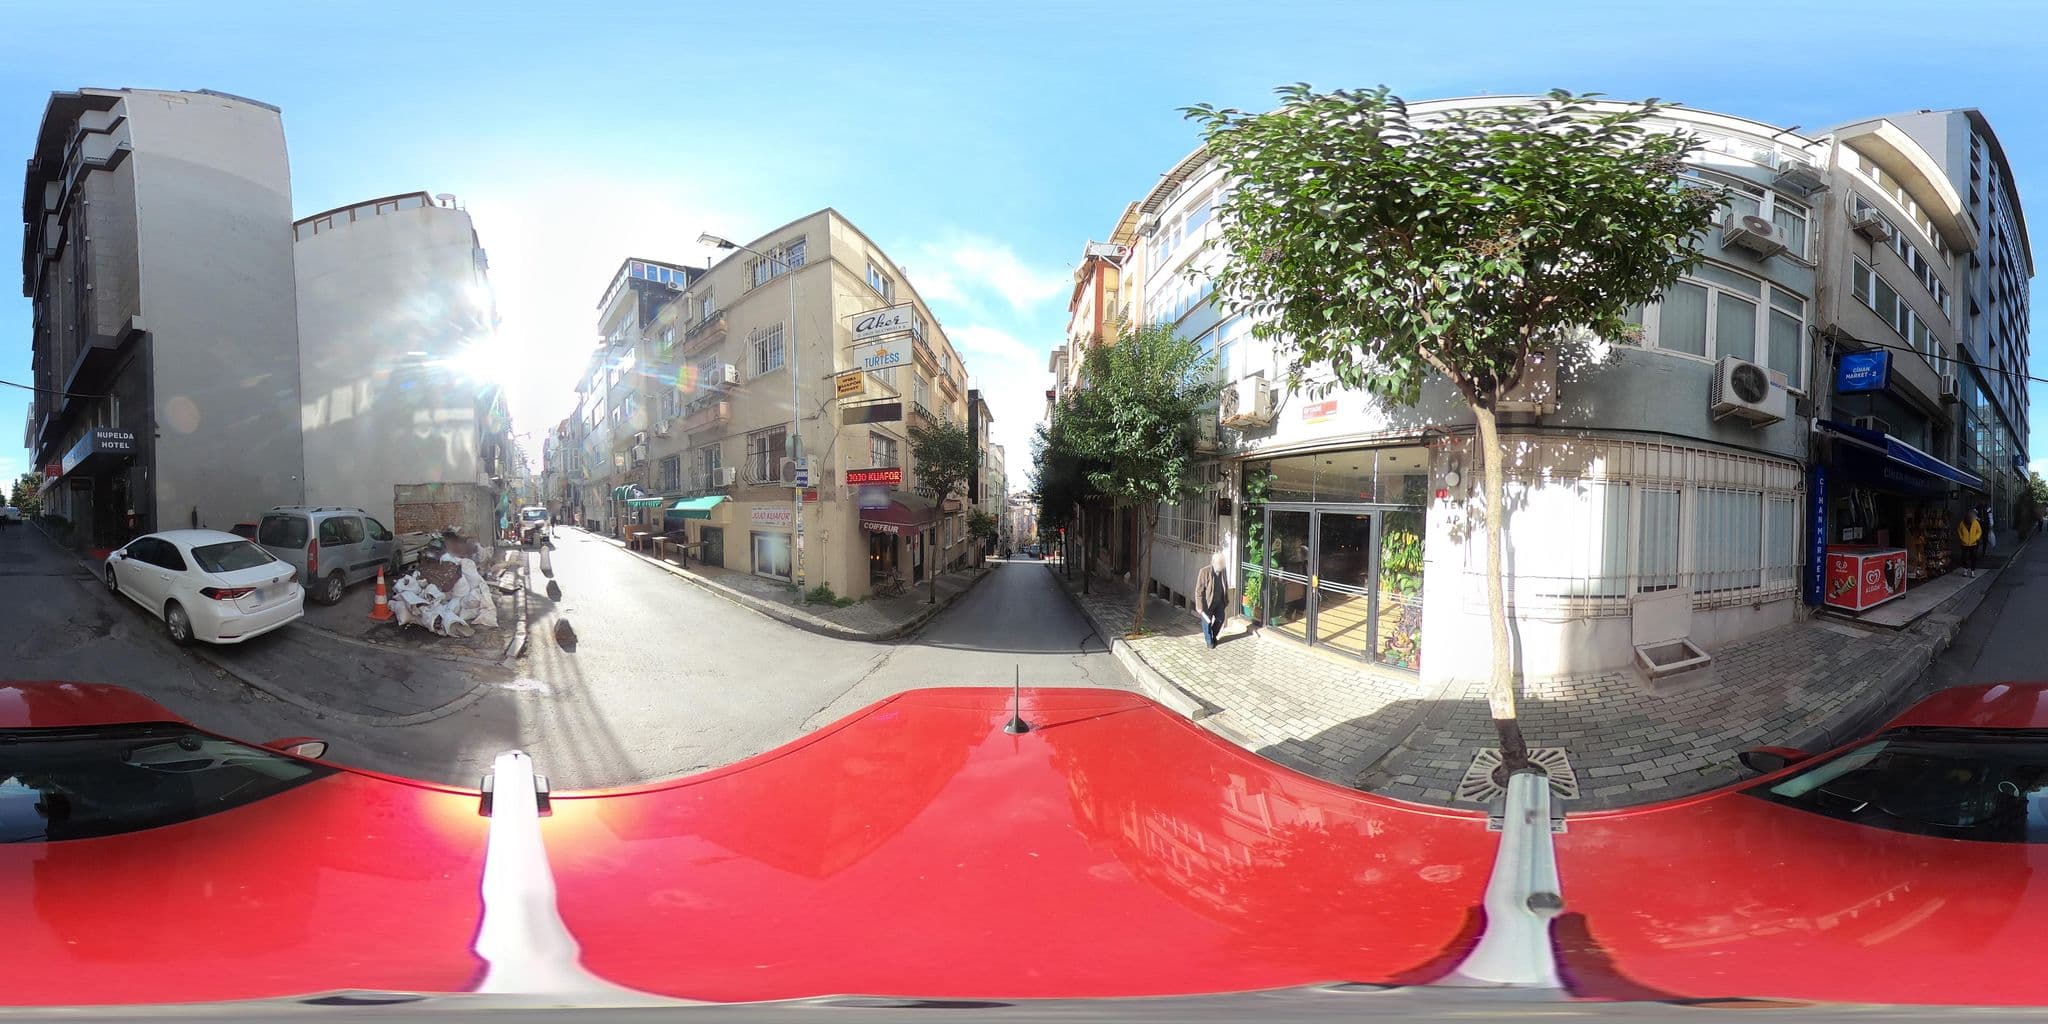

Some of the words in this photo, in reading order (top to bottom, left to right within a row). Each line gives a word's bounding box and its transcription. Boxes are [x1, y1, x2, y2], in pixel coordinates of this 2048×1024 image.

[865, 353, 900, 368] TURTESS
[1846, 372, 1868, 380] MARKET
[97, 432, 134, 440] NUPELDA
[848, 473, 866, 482] JOJO
[864, 522, 899, 533] COIFFEUR
